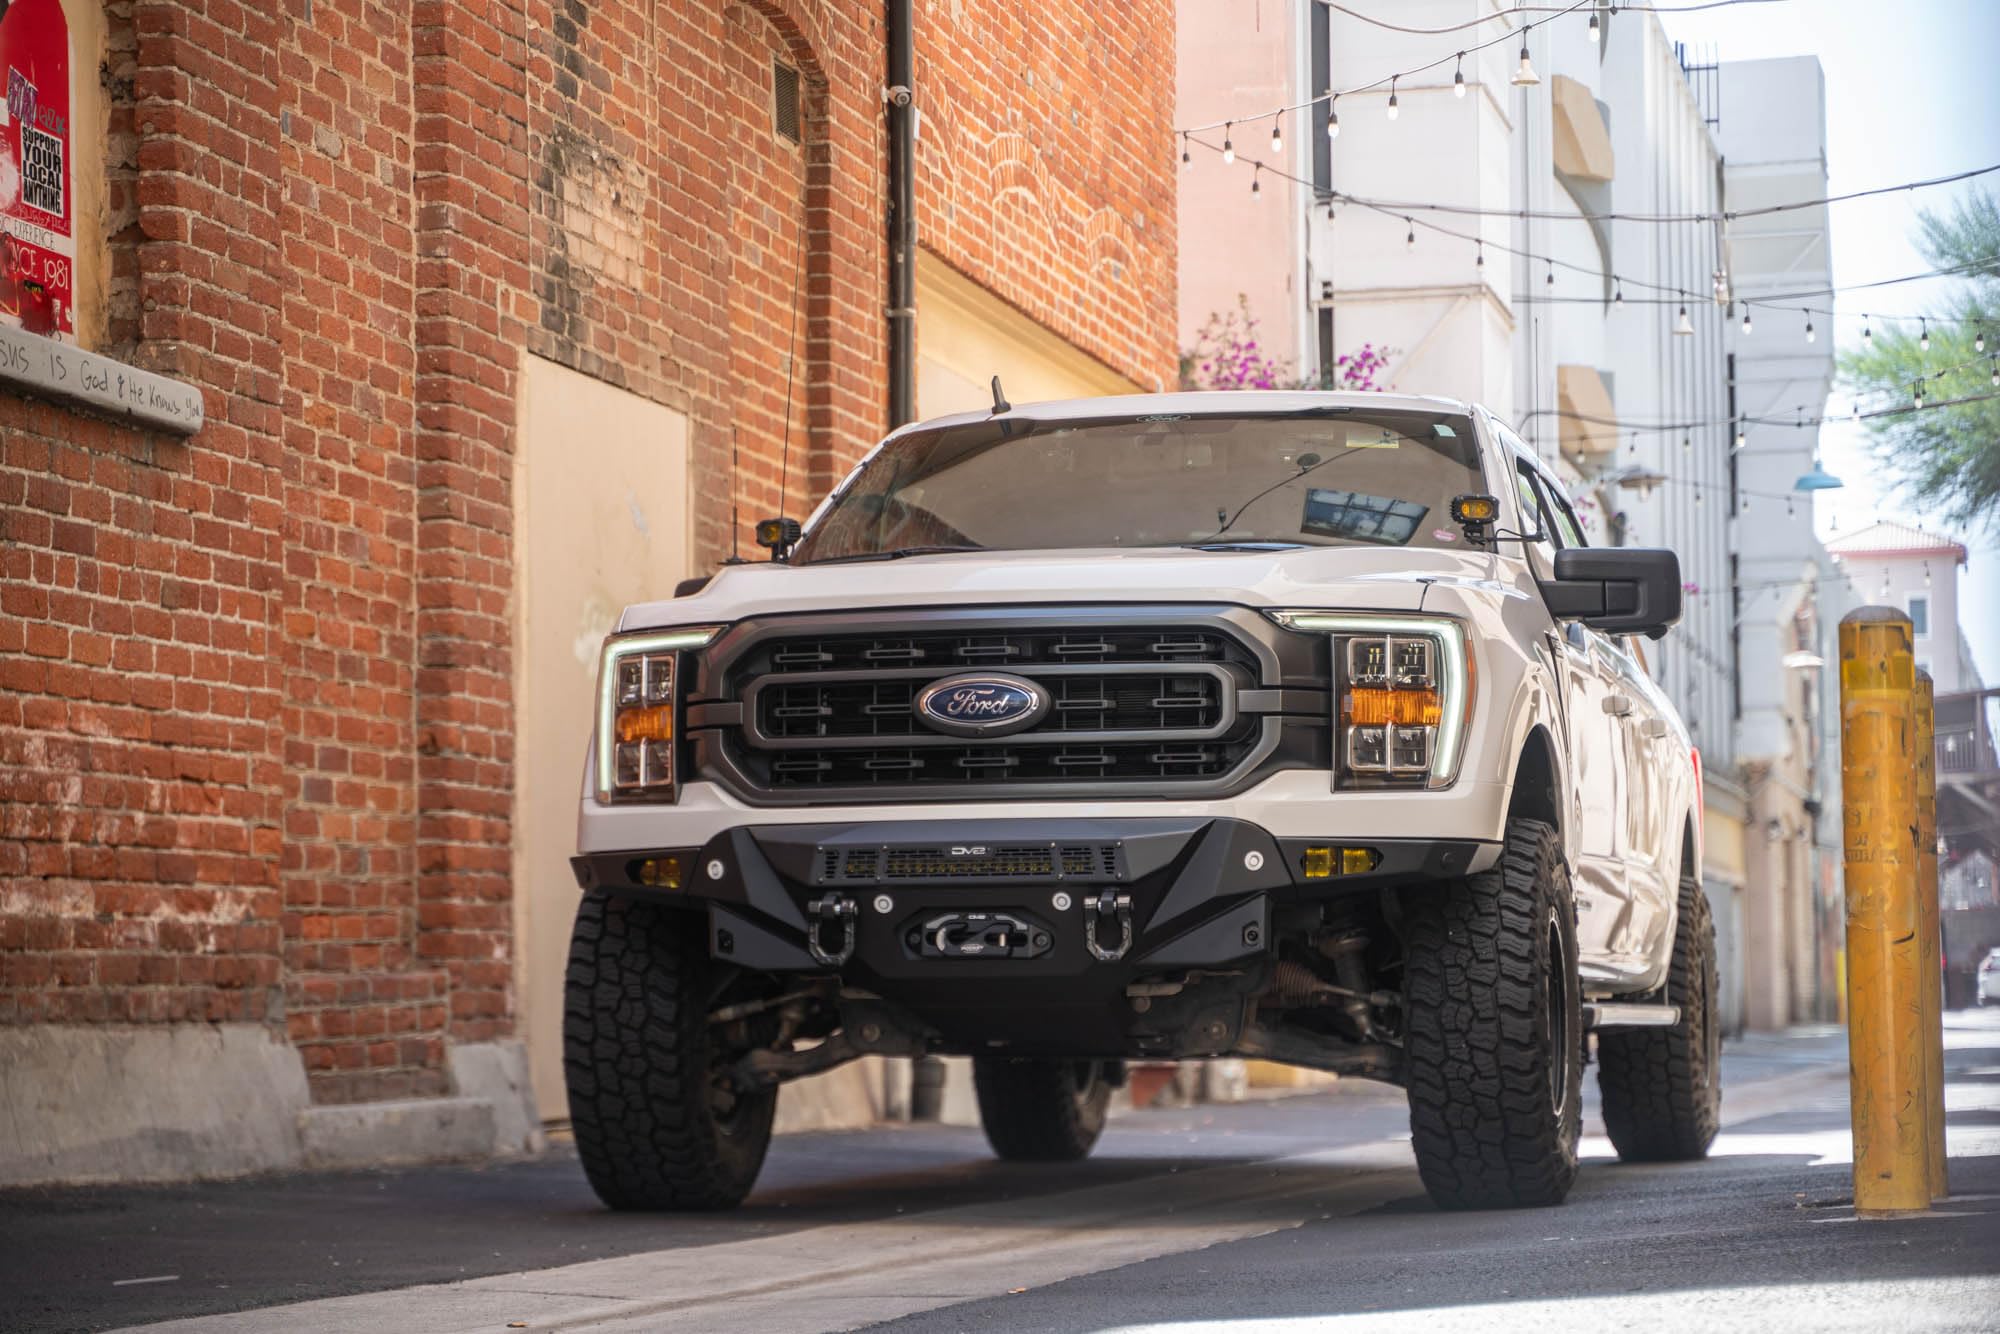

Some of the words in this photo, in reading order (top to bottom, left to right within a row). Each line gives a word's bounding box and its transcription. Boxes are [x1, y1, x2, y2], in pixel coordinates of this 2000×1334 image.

[22, 126, 61, 155] SUPPORT
[23, 141, 61, 174] YOUR
[23, 160, 61, 191] LOCAL
[23, 178, 62, 214] ANYTHING.
[14, 218, 55, 251] EXPERIENCE
[43, 257, 69, 290] 1981
[80, 360, 108, 392] God
[129, 375, 144, 405] He
[947, 688, 1010, 715] Ford
